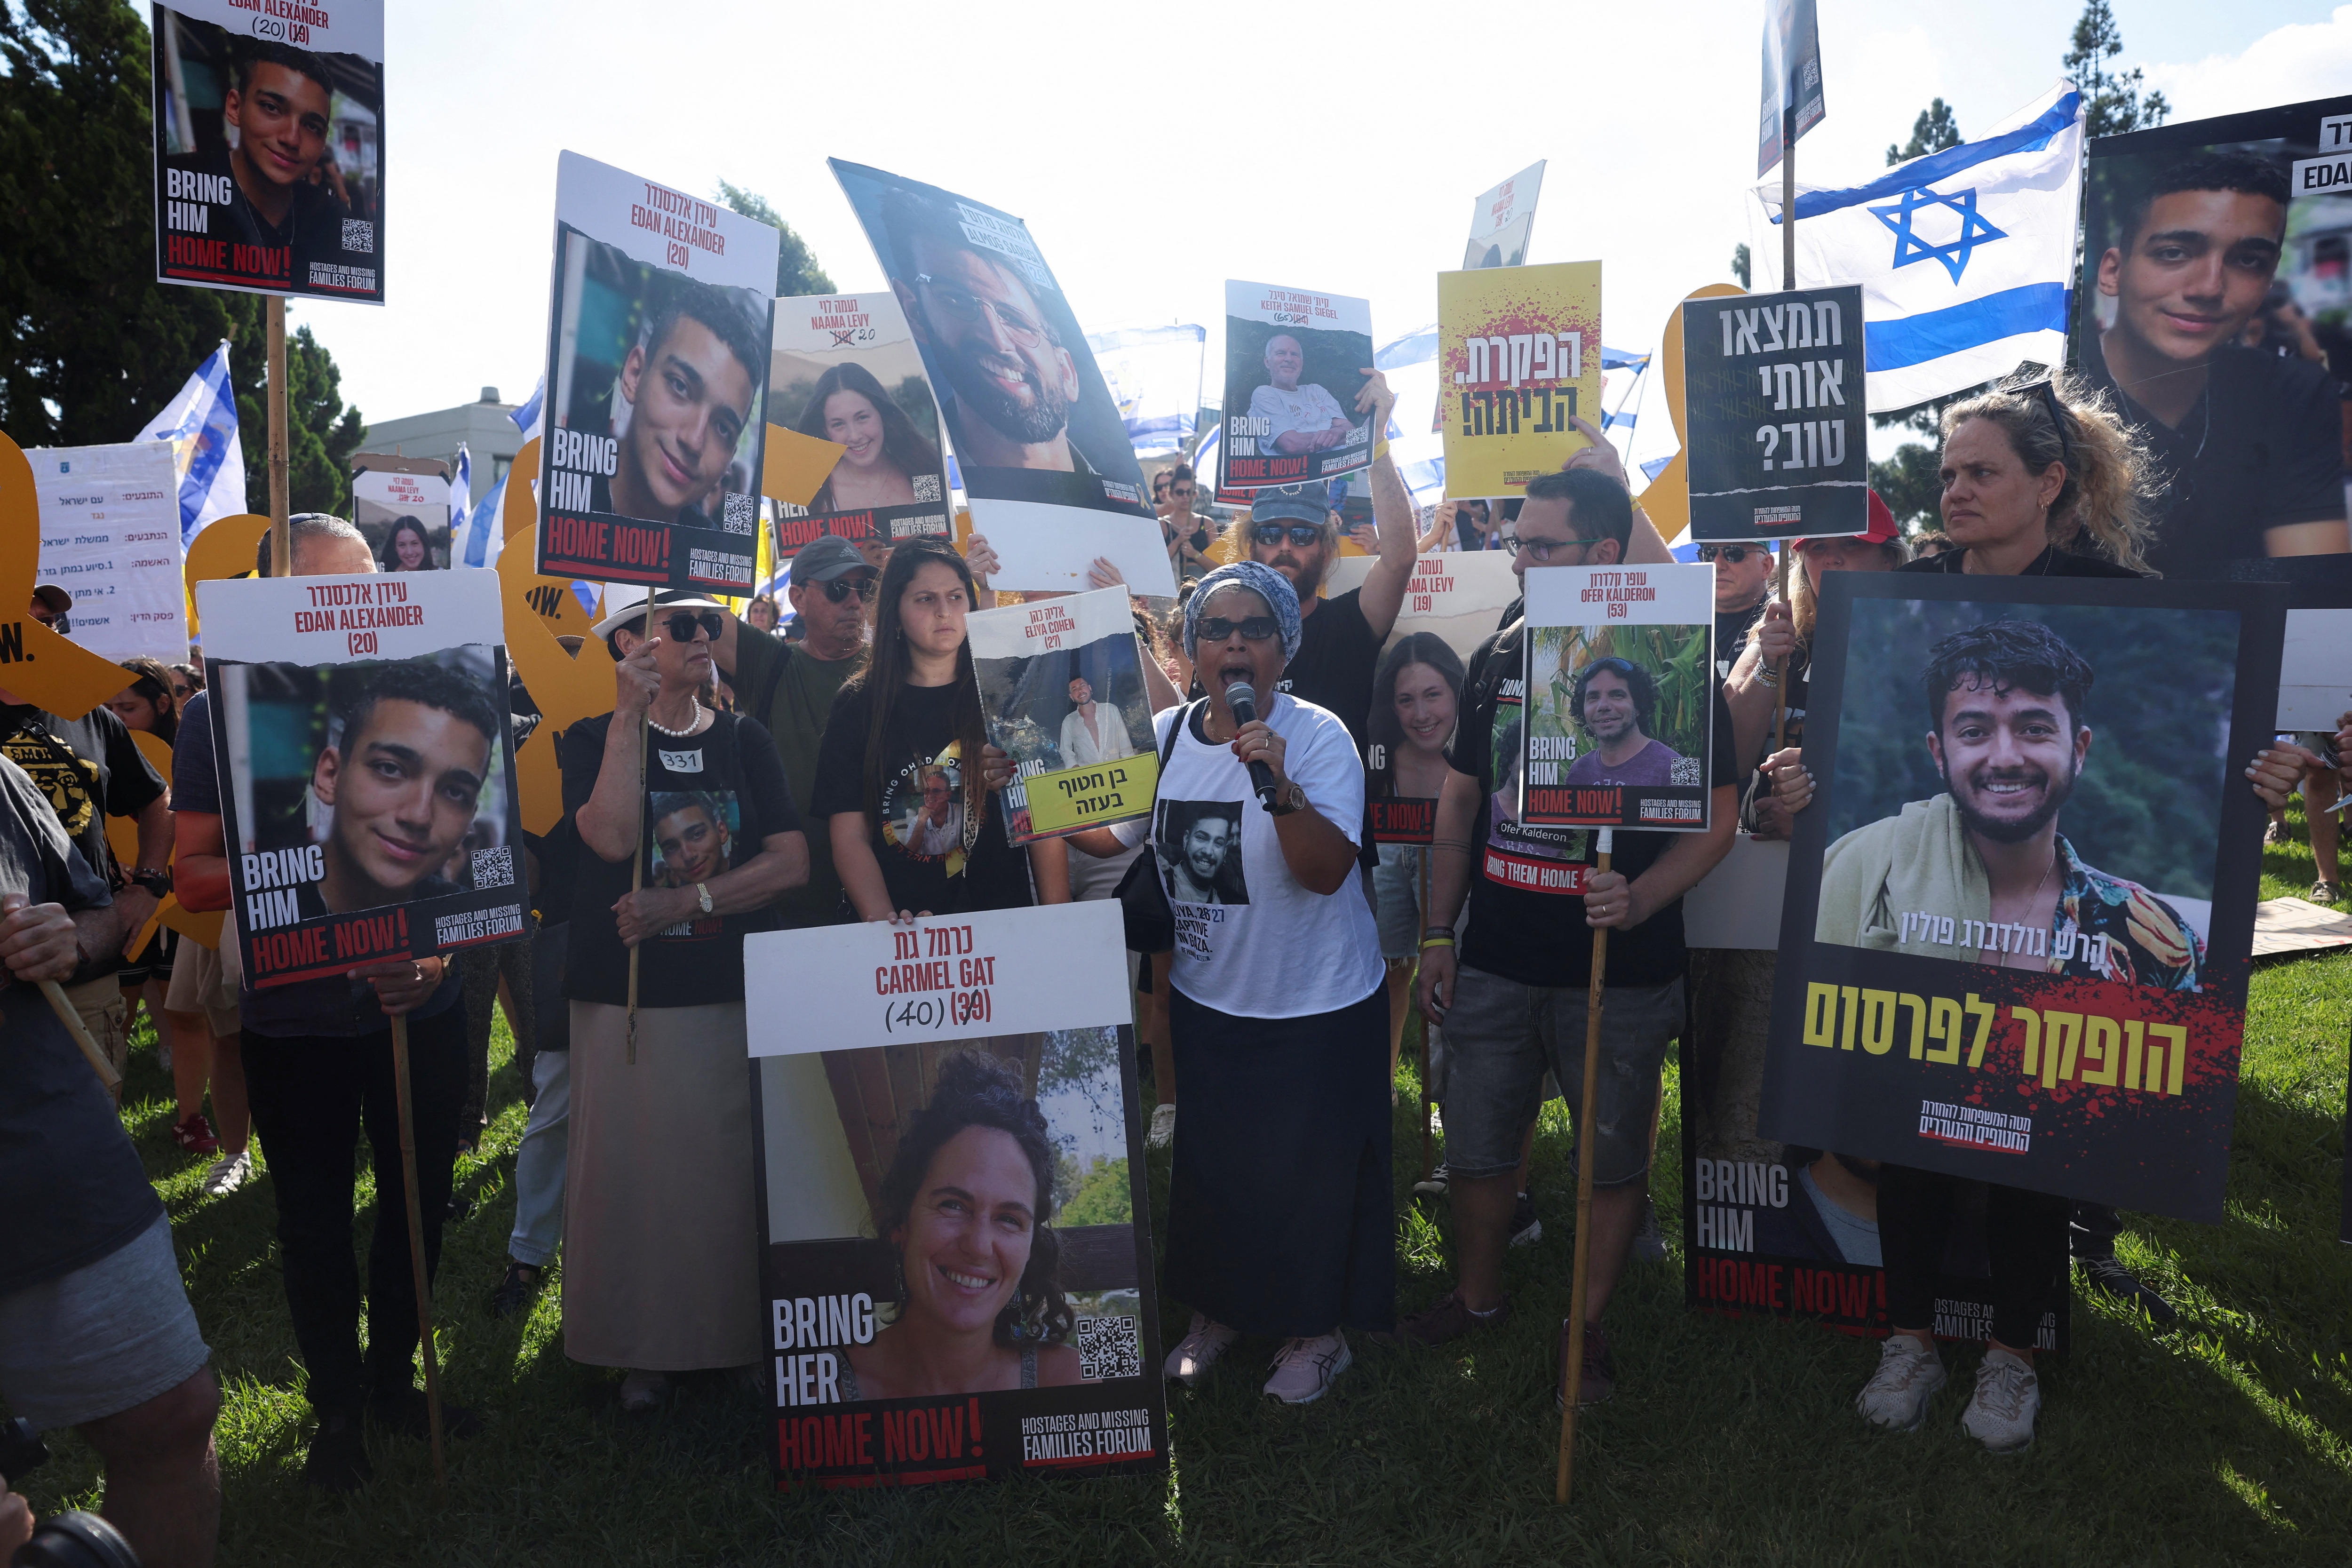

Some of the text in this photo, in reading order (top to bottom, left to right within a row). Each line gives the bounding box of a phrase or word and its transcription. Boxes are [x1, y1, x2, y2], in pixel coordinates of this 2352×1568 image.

[264, 0, 329, 29] ALEXANDER
[252, 16, 285, 40] (20)
[1811, 101, 1822, 120] FORUM
[167, 168, 231, 206] BRING
[168, 200, 207, 233] HIM
[644, 183, 716, 229] עידן אלכסנדר
[631, 204, 725, 256] EDAN ALEXANDER
[168, 235, 290, 277] HOME NOW!
[667, 240, 689, 270] (20)
[967, 228, 1039, 264] ALMOG SARUSI
[310, 262, 375, 278] HOSTAGES AND MISSING
[310, 271, 375, 290] FAMILIES FORUM
[819, 299, 858, 313] נעמה לוי
[1261, 300, 1338, 319] KEITH SAMUEL SIEGEL
[1269, 290, 1312, 304] שמואל סיגל
[811, 313, 869, 330] NAAMA LEVY
[858, 328, 875, 340] 20
[1719, 300, 1842, 356] תמצאו
[1455, 331, 1581, 388] הפקרת.
[1759, 359, 1845, 411] אותי
[1462, 387, 1577, 437] הביתה!
[1231, 416, 1270, 437] BRING
[552, 428, 617, 476] BRING
[1230, 438, 1255, 456] HIM
[1351, 449, 1367, 458] MISSING
[1756, 419, 1845, 471] טוב?
[1230, 455, 1308, 478] HOME NOW!
[1321, 455, 1367, 473] FAMILIES FORUM
[59, 491, 163, 506] התובעים: עם ישראל
[549, 470, 592, 513] HIM
[829, 510, 874, 540] NOW!
[890, 518, 914, 527] HOSTAGES
[925, 514, 945, 523] MISSING
[923, 523, 946, 534] FORUM
[1755, 512, 1801, 523] החטופים והנעדרים
[41, 532, 167, 547] הנתבעים: ממשלת ישראל
[547, 516, 670, 568] HOME NOW!
[61, 558, 169, 576] האשמה: במתן
[690, 548, 752, 567] HOSTAGES AND MISSING
[1418, 559, 1443, 575] נעמה
[689, 560, 751, 584] FAMILIES FORUM
[1430, 577, 1454, 592] LEVY
[1590, 572, 1647, 589] עופר קלדרון
[75, 589, 92, 599] מתן
[307, 582, 407, 607] עידן אלכסנדר
[1414, 595, 1431, 612] (19)
[1581, 588, 1655, 603] OFER KALDERON
[131, 613, 173, 622] פסק הדין:
[294, 605, 424, 633] EDAN ALEXANDER
[1029, 605, 1065, 624] אליה כהן
[1607, 602, 1628, 619] (53)
[1025, 618, 1075, 638] ELIYA COHEN
[348, 630, 378, 656] (20)
[1044, 634, 1061, 650] (27)
[663, 753, 697, 768] 331
[1530, 736, 1576, 760] BRING
[1058, 768, 1128, 798] בן חטוף
[1529, 762, 1558, 785] HIM
[883, 779, 898, 814] BRING
[1076, 792, 1124, 815] בעזה
[1528, 787, 1622, 815] HOME NOW!
[1640, 798, 1667, 808] HOSTAGES
[1678, 800, 1701, 808] MISSING
[1388, 802, 1431, 831] NOW!
[1640, 807, 1701, 820] FAMILIES FORUM
[1501, 823, 1566, 842] Ofer Kalderon
[241, 845, 325, 891] BRING
[1487, 855, 1578, 889] BRING THEM HOME
[246, 888, 300, 931] HIM
[435, 903, 521, 929] HOSTAGES AND MISSING
[252, 907, 410, 974] HOME NOW!
[437, 915, 523, 945] FAMILIES FORUM
[894, 925, 973, 961] כרמל גת
[1176, 932, 1188, 944] IN
[1900, 910, 2108, 965] הרש גולדברג פולין
[876, 956, 995, 995] CARMEL GAT
[885, 998, 944, 1033] (40)
[1803, 980, 2189, 1097] הופקר לפרסום
[1921, 1100, 2031, 1132] מטה המשפחות להחזרת
[1919, 1115, 2030, 1152] החטופים והנעדרים
[1696, 1157, 1788, 1209] BRING
[1697, 1205, 1754, 1253] HIM
[1699, 1256, 1887, 1322] HOME NOW!
[772, 1292, 874, 1351] BRING
[776, 1353, 842, 1407] HER
[778, 1397, 984, 1471] HOME NOW!
[1022, 1409, 1149, 1435] HOSTAGES AND MISSING
[1023, 1426, 1152, 1461] FAMILIES FORUM
